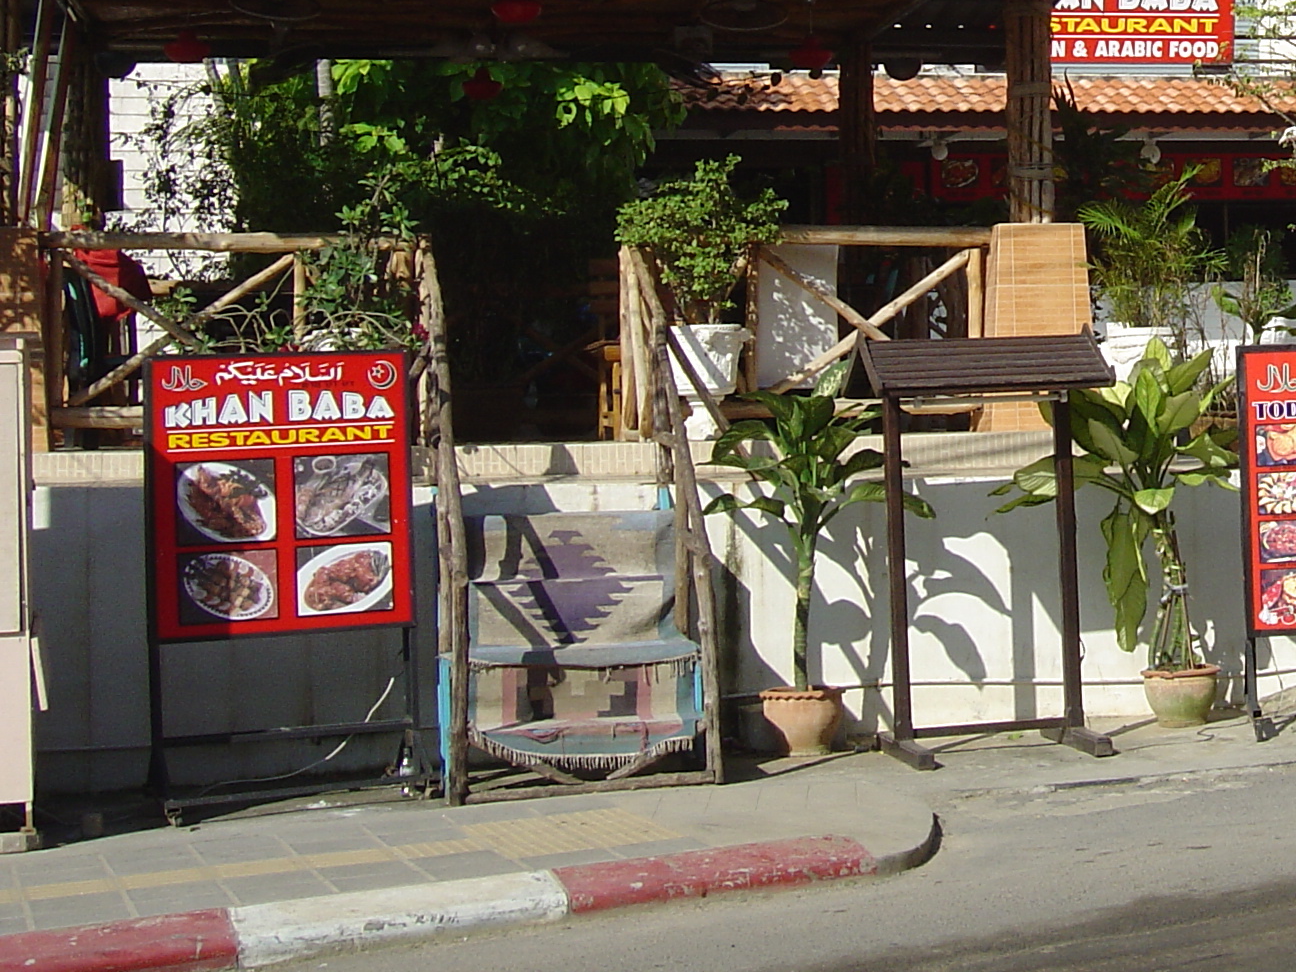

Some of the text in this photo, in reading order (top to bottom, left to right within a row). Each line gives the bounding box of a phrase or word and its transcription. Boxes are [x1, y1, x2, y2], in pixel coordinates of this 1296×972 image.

[1072, 41, 1088, 57] &
[1094, 41, 1162, 57] ARABIC
[1168, 41, 1219, 57] FOOD
[164, 389, 395, 428] KHAN BABA
[168, 424, 394, 449] RESTAURANT
